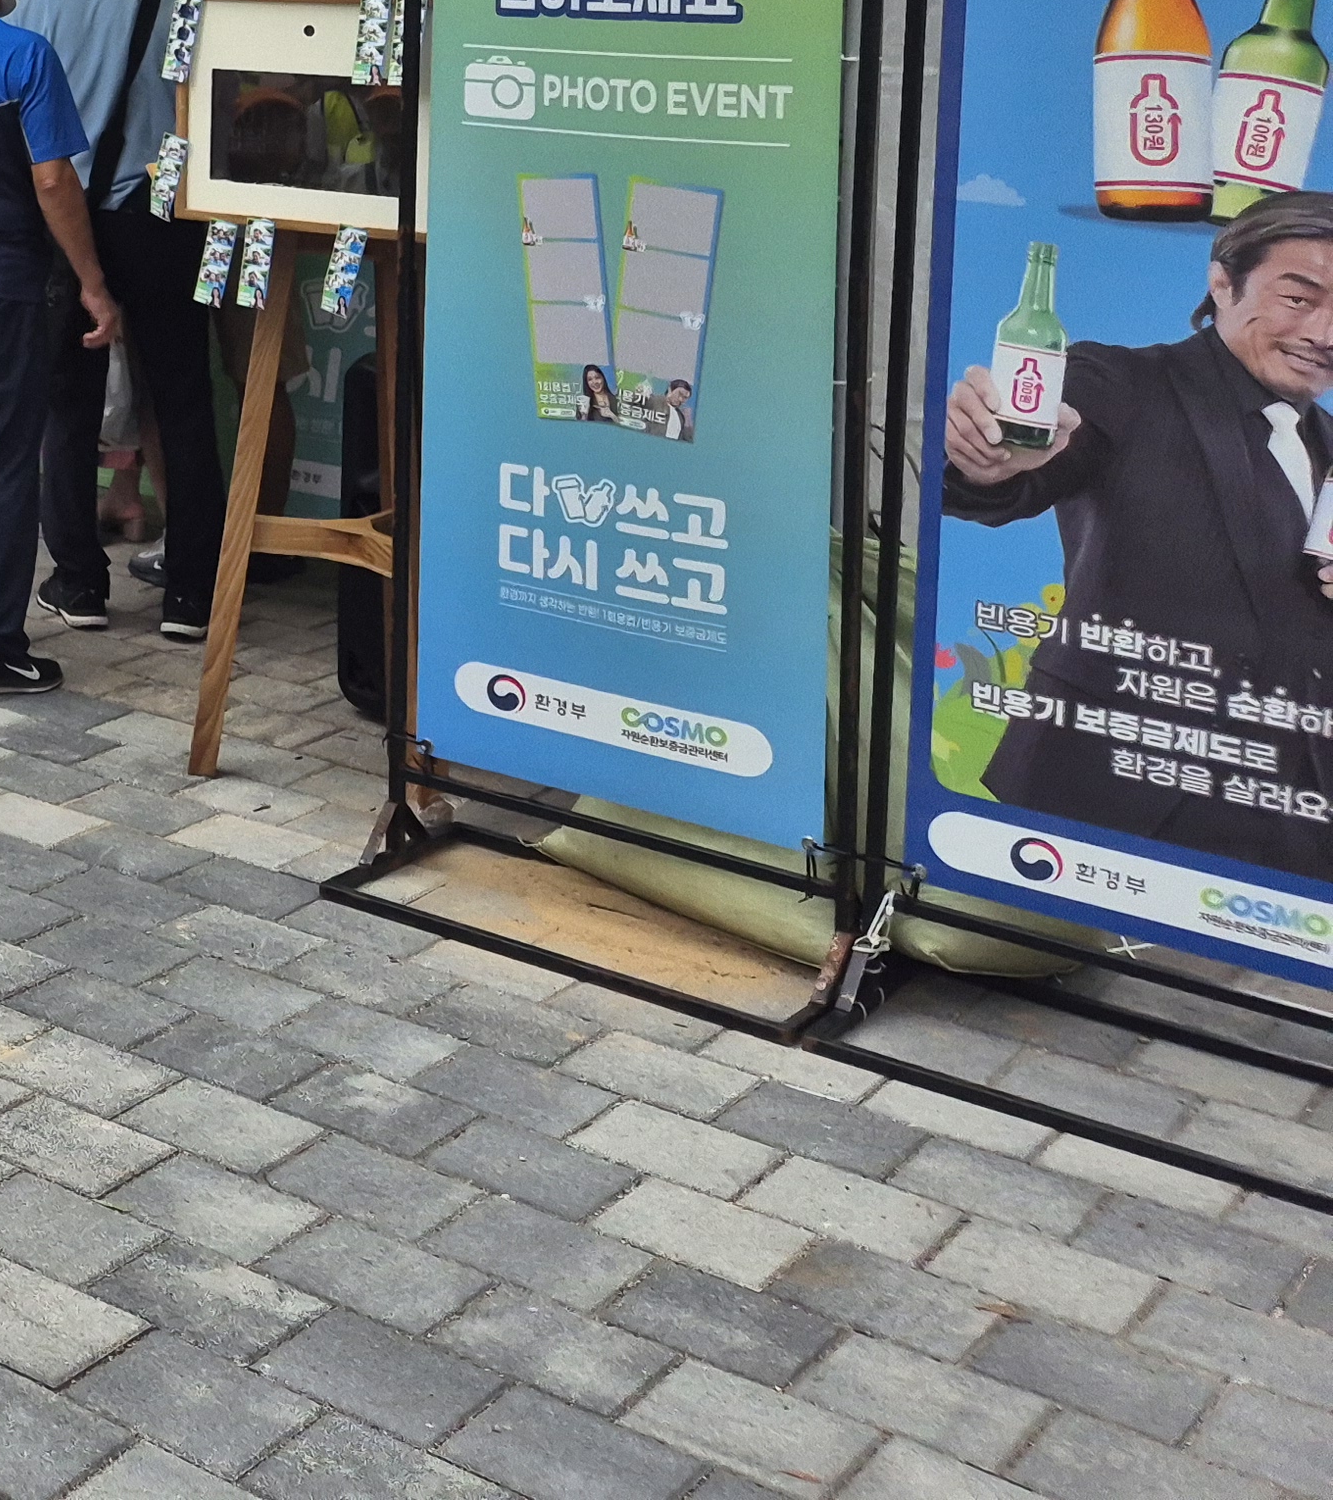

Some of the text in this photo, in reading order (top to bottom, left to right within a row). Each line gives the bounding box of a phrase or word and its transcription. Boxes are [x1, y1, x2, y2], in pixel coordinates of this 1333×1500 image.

[542, 73, 794, 120] PHOTO EVENT
[1142, 102, 1166, 152] 130원
[1244, 116, 1272, 160] 100원
[498, 462, 729, 550] 다 쓰고
[498, 523, 728, 616] 다시 쓰고
[975, 601, 1223, 678] 빈용기 반환하고,
[1116, 667, 1217, 713] 자원은
[534, 693, 729, 749] 환경부 COSMO
[971, 681, 1279, 775] 빈용기 보증금제도로
[1111, 748, 1214, 797] 환경을
[1075, 861, 1333, 938] 환경부 COSMO
